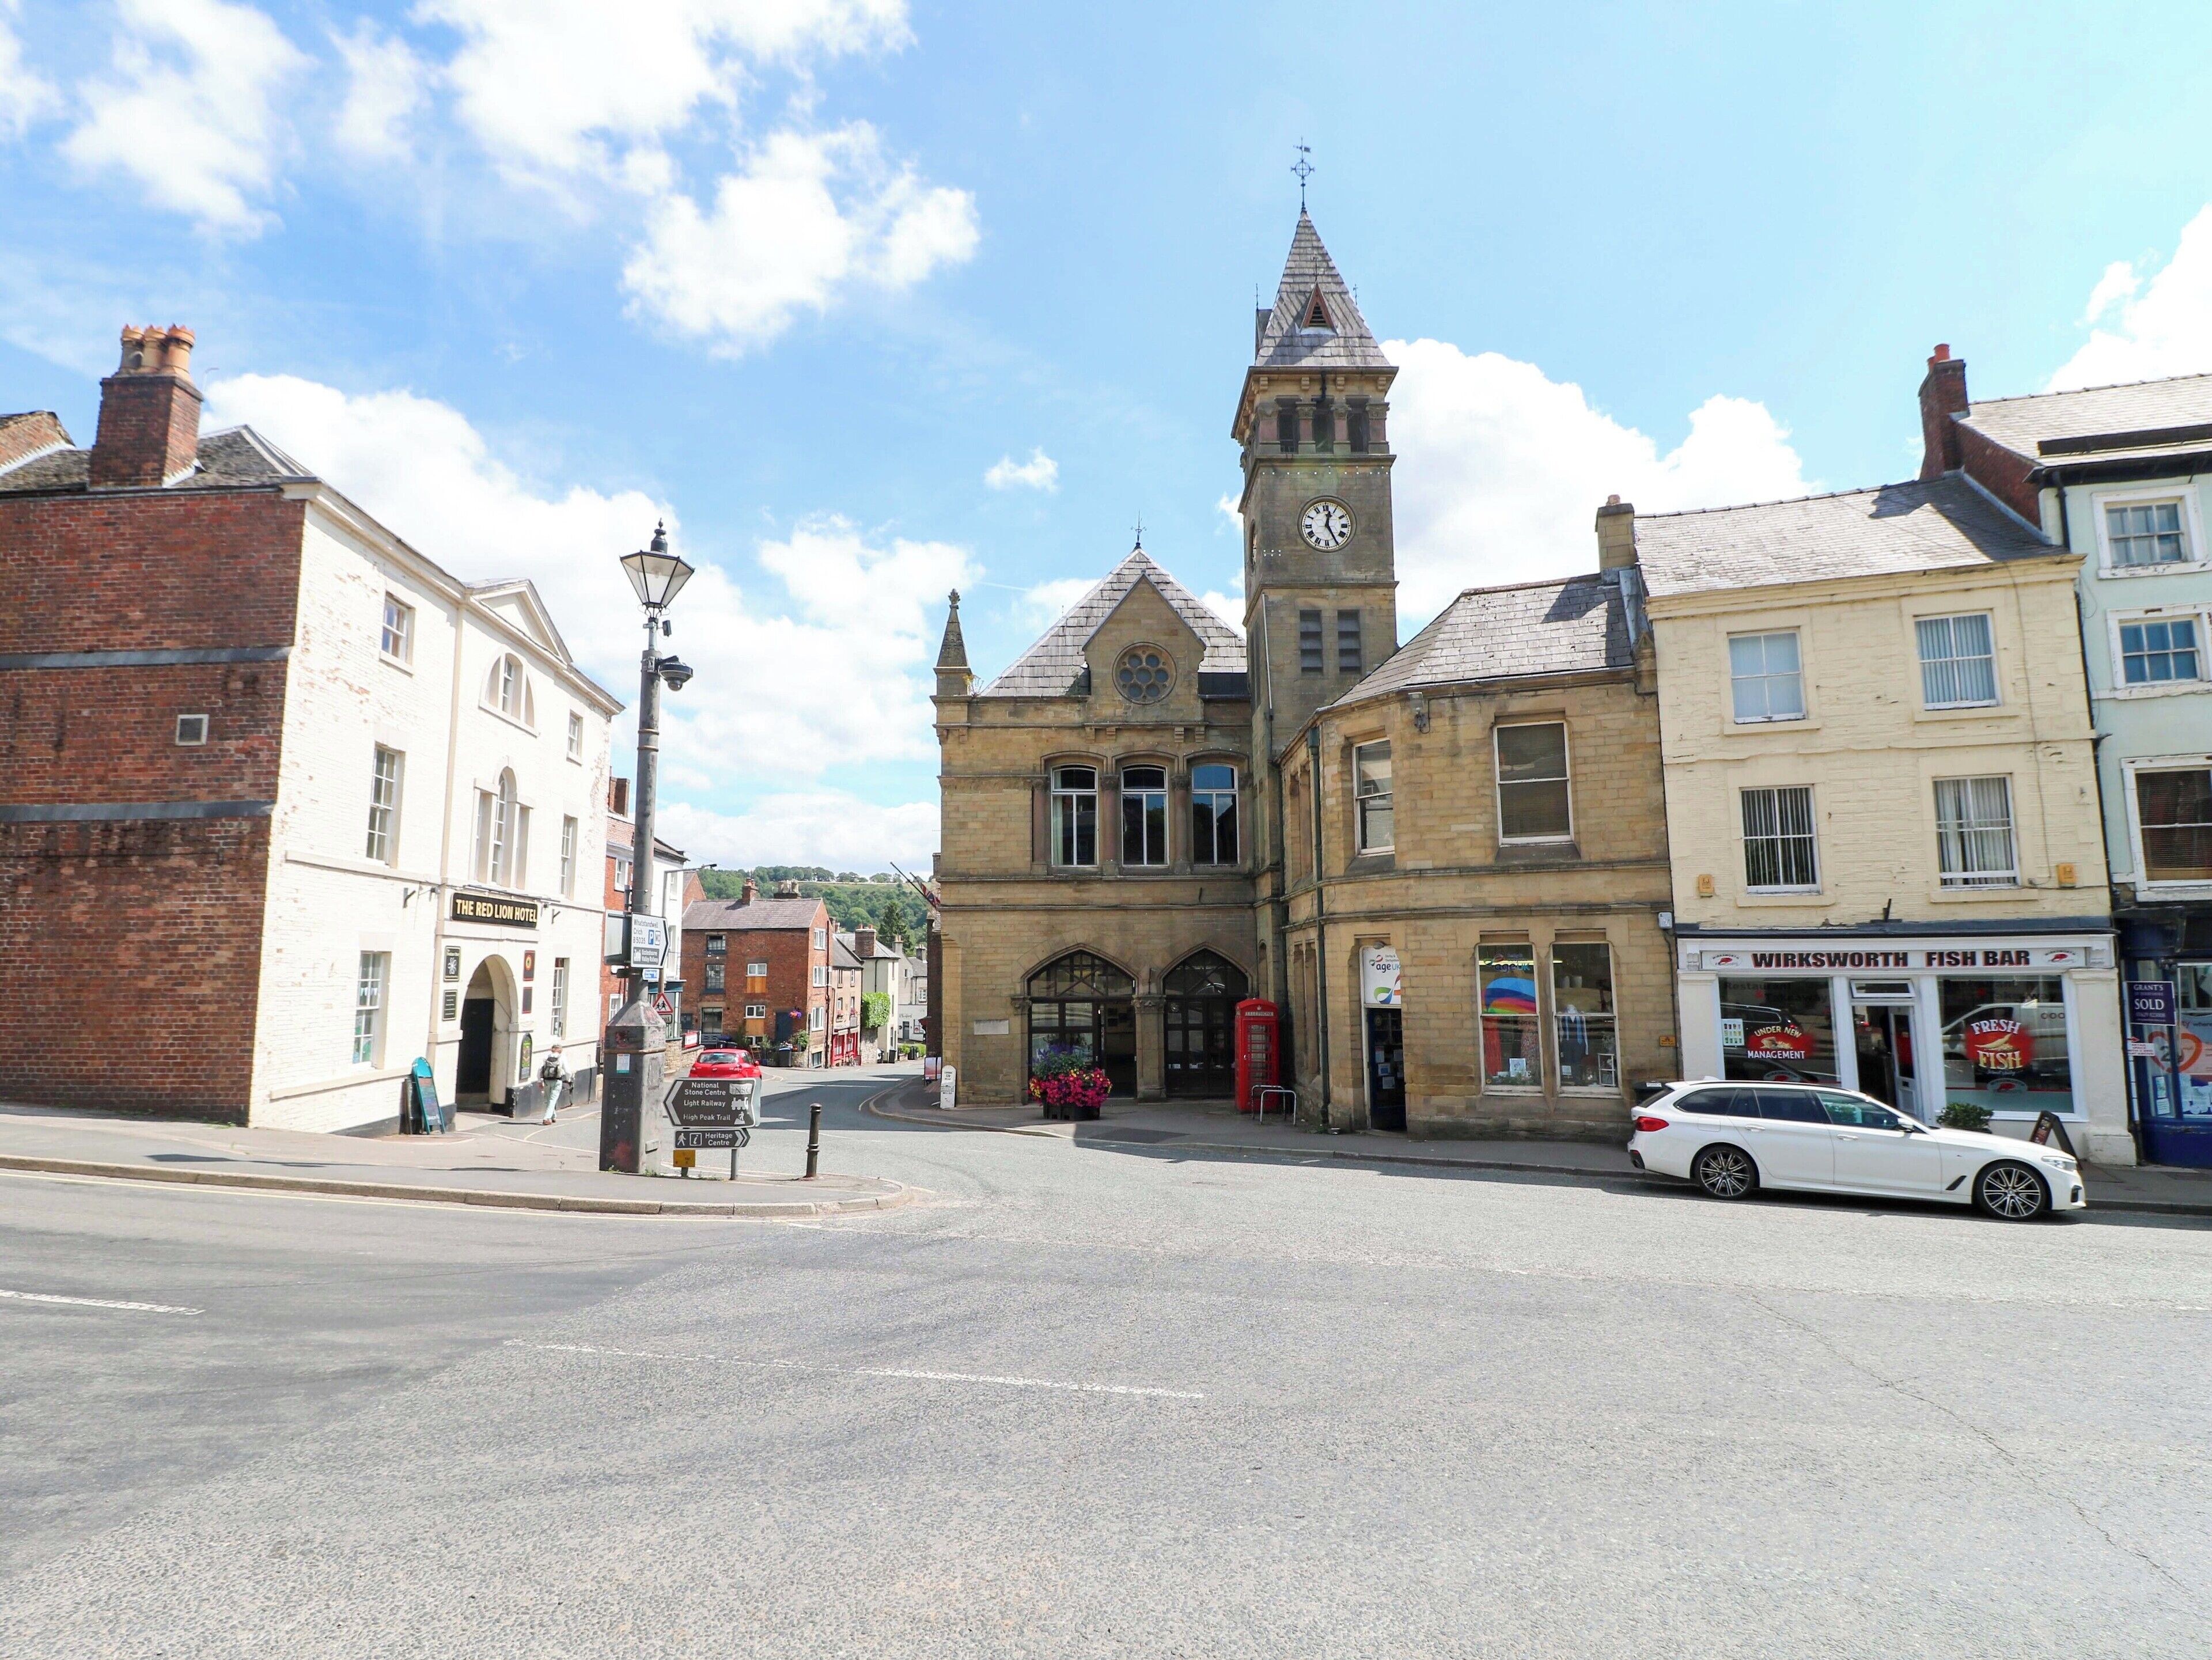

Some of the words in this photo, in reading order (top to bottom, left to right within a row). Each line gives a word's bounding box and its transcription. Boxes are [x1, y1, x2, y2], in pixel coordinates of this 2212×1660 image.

[456, 899, 474, 916] THE
[475, 901, 494, 918] RED
[494, 904, 513, 920] LION
[514, 907, 537, 922] HOTEL
[634, 919, 658, 928] Whatstandwell
[1751, 952, 1908, 968] WIRKSWORTH
[1925, 951, 1976, 967] FISH
[1982, 950, 2031, 966] BAR
[2134, 999, 2164, 1010] SOLD
[1754, 1026, 1782, 1037] UNDER
[1784, 1026, 1802, 1038] NEW
[1971, 1019, 2021, 1035] FRESH
[1747, 1050, 1805, 1059] MANAGEMENT
[1977, 1050, 2022, 1070] FISH
